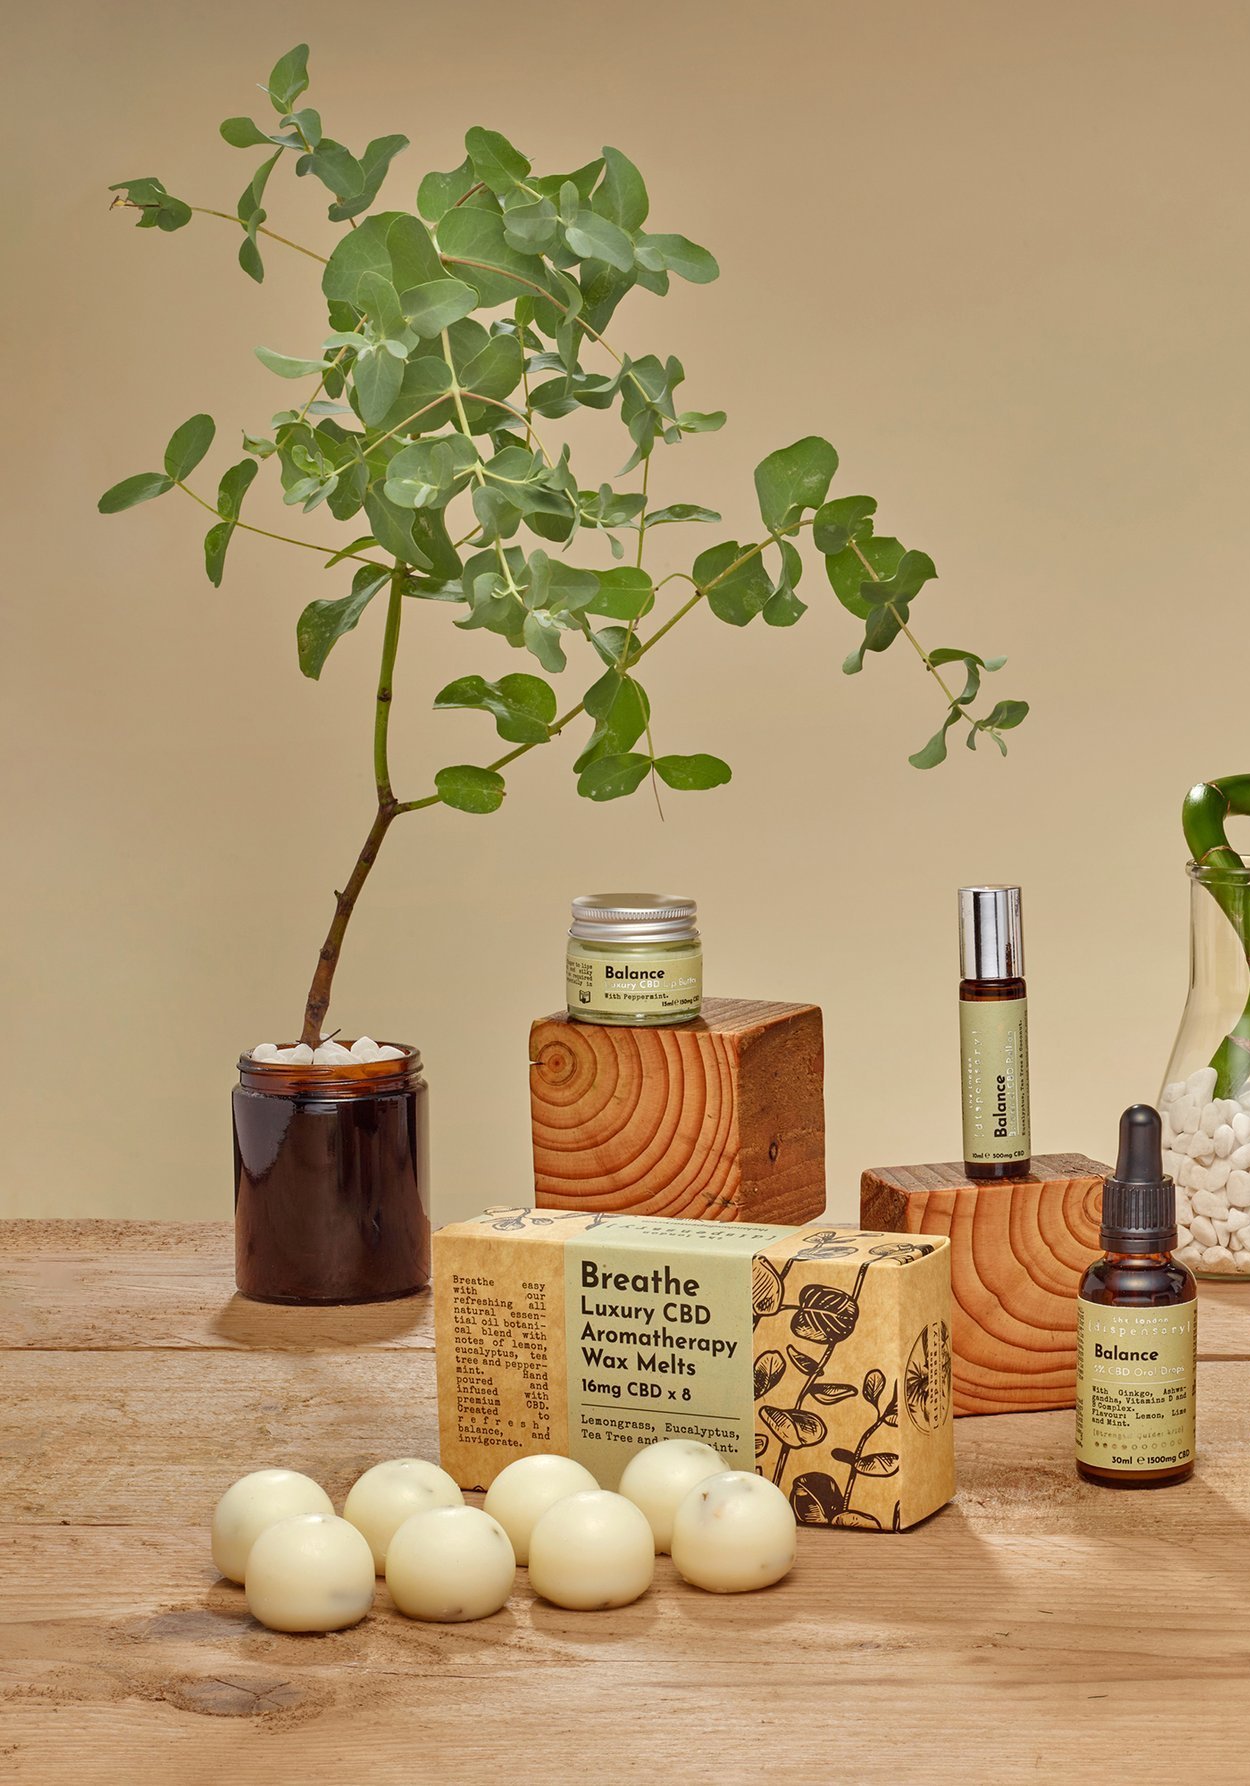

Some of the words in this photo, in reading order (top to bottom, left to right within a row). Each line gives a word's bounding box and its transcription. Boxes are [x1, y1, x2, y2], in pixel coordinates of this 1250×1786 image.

[605, 966, 665, 979] Balance
[993, 1075, 1007, 1137] Balance
[453, 1275, 495, 1286] Breathe
[522, 1282, 545, 1292] easy
[582, 1260, 700, 1297] Breathe
[453, 1286, 477, 1295] with
[527, 1292, 545, 1300] our
[453, 1297, 513, 1309] refreshing
[528, 1302, 546, 1310] all
[581, 1295, 655, 1325] Luxury
[663, 1303, 711, 1324] CBD
[454, 1306, 496, 1316] natural
[510, 1311, 546, 1320] essen-
[454, 1316, 477, 1325] tial
[482, 1318, 499, 1326] oil
[504, 1319, 546, 1329] botani-
[454, 1326, 472, 1334] cal
[481, 1328, 512, 1338] blend
[522, 1331, 547, 1340] with
[581, 1322, 737, 1358] Aromatherapy
[455, 1337, 484, 1345] notes
[493, 1339, 504, 1347] of
[512, 1340, 547, 1352] lemon,
[455, 1347, 518, 1359] eucalyptus,
[530, 1352, 547, 1360] tea
[1095, 1343, 1159, 1361] Balance
[456, 1356, 478, 1365] tree
[482, 1358, 501, 1366] and
[505, 1360, 547, 1370] pepper-
[582, 1347, 628, 1369] Wax
[637, 1352, 695, 1376] Melts
[456, 1366, 484, 1374] mint.
[523, 1370, 548, 1380] Hand
[1109, 1367, 1130, 1376] CBD
[1134, 1367, 1157, 1376] Oral
[1161, 1366, 1185, 1376] Drops
[456, 1376, 493, 1387] poured
[529, 1382, 548, 1390] and
[582, 1379, 621, 1398] 16mg
[628, 1382, 661, 1398] CBD
[668, 1390, 676, 1400] x
[682, 1388, 691, 1400] 8
[457, 1385, 499, 1395] infused
[525, 1391, 549, 1400] with
[1092, 1386, 1109, 1395] With
[1118, 1389, 1153, 1398] Ginkgo,
[1163, 1386, 1187, 1395] Ashwa-
[1092, 1394, 1122, 1405] gandha,
[1126, 1396, 1166, 1405] Vitamins
[1175, 1392, 1187, 1400] and
[457, 1396, 500, 1405] premium
[526, 1401, 549, 1410] CBD.
[1097, 1403, 1135, 1413] Complex.
[458, 1405, 499, 1415] Created
[538, 1411, 549, 1420] to
[1091, 1410, 1127, 1419] Flavour:
[1171, 1407, 1187, 1416] Lime
[581, 1415, 656, 1432] Lemongrass,
[665, 1422, 740, 1440] Eucalyptus,
[1091, 1417, 1104, 1425] and
[1107, 1419, 1130, 1427] Mint.
[458, 1424, 503, 1437] balance,
[531, 1431, 550, 1440] and
[581, 1429, 601, 1439] Tea
[606, 1431, 632, 1442] Tree
[637, 1435, 658, 1444] and
[458, 1434, 523, 1447] invigorate.
[1112, 1456, 1133, 1464] 30ml
[1147, 1455, 1177, 1465] 1500mg
[1178, 1450, 1190, 1459] CBD
